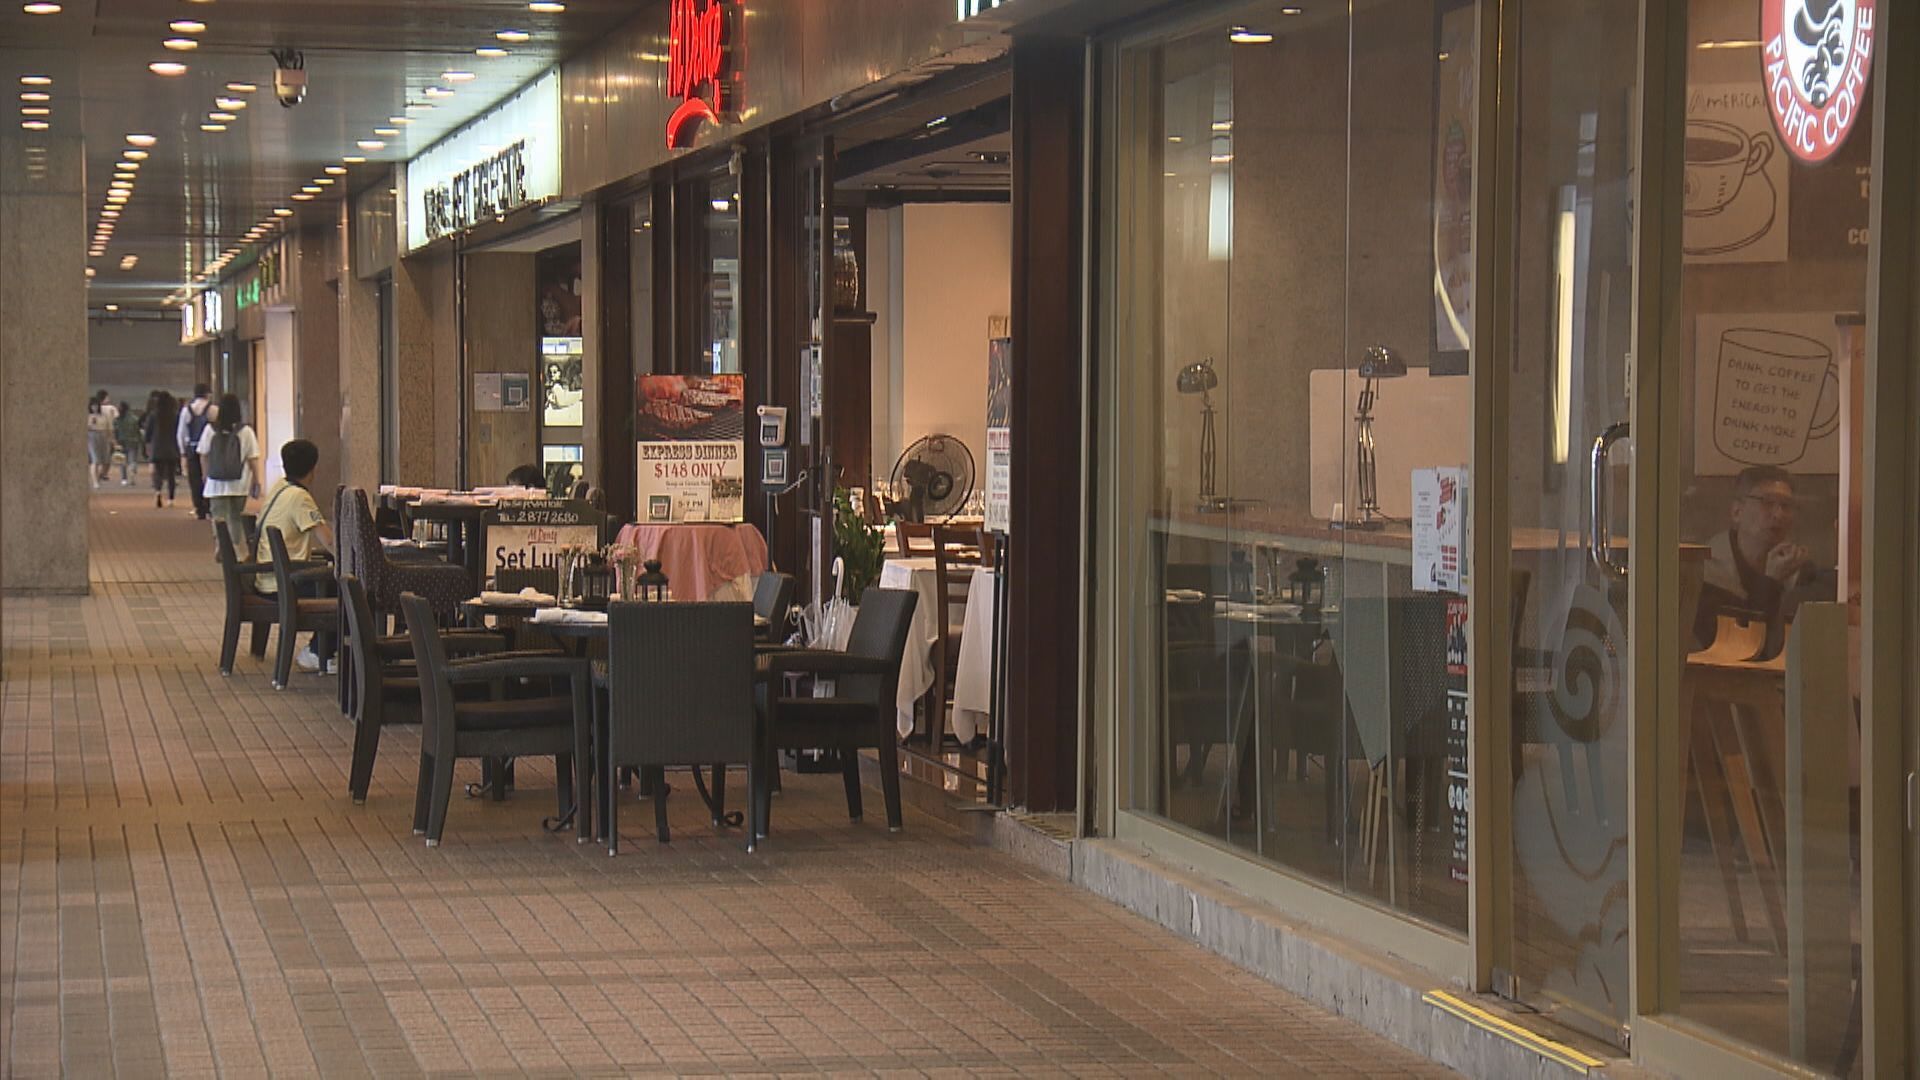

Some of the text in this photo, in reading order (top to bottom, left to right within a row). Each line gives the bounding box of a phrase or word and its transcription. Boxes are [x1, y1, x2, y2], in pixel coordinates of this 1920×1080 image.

[1766, 7, 1873, 152] PACIFIC COFFEE
[1728, 359, 1816, 383] DRINK COFFEE
[1735, 379, 1801, 400] TO GET THE
[1731, 399, 1797, 419] ENERGY TO
[1723, 416, 1797, 439] DRINK MORE
[642, 444, 738, 460] EXPRESS DINNER
[1732, 439, 1781, 455] COFFEE
[654, 460, 727, 480] $148 ONLY
[495, 545, 527, 569] Set
